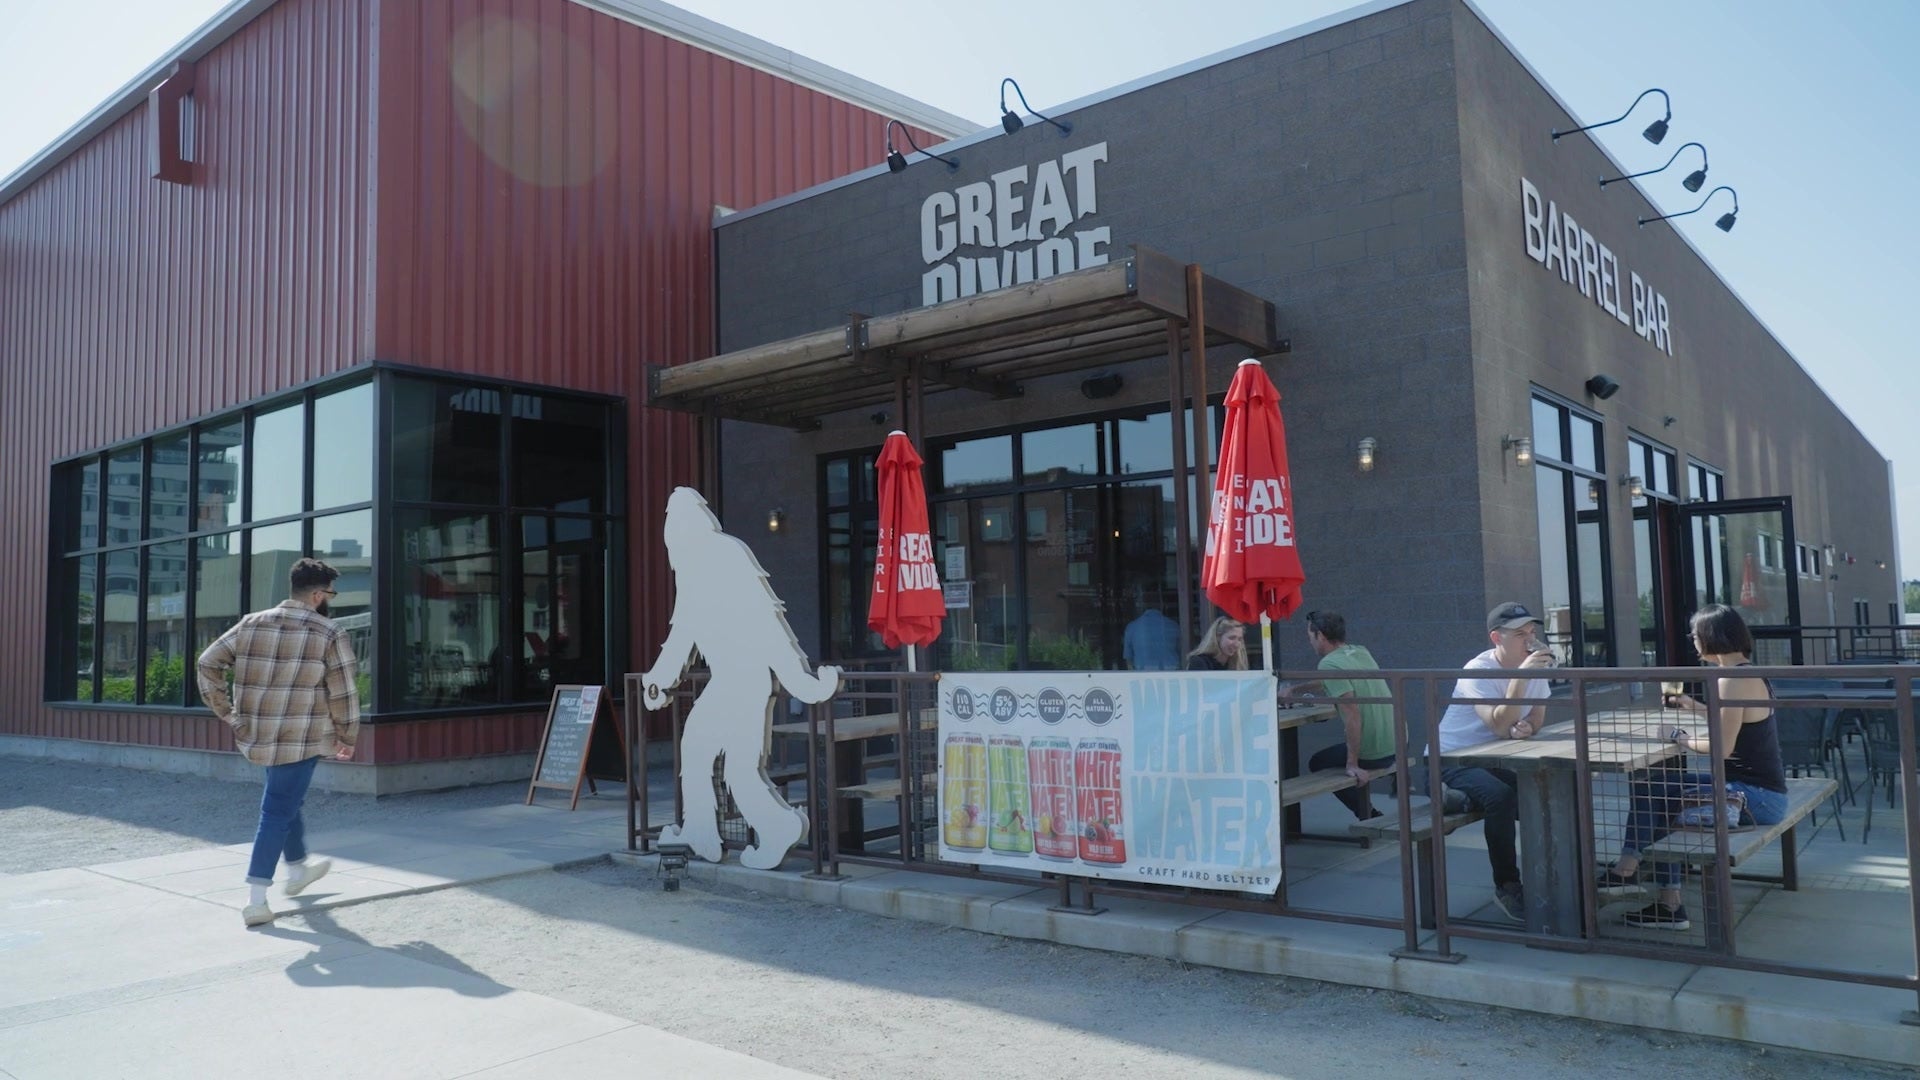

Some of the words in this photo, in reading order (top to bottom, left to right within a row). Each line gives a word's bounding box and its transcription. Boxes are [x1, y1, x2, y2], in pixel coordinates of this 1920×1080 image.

[921, 141, 1108, 265] GREAT
[1521, 176, 1631, 327] BARREL
[1630, 270, 1673, 357] BAR
[957, 704, 972, 715] CAL
[994, 706, 1013, 717] ABV
[995, 695, 1014, 707] 5%
[1085, 704, 1113, 713] NATURAL
[1130, 678, 1271, 774] WHITE
[1076, 751, 1122, 789] WHITE
[1130, 775, 1272, 868] WATER
[1138, 866, 1176, 877] CRAFT
[1181, 870, 1210, 881] HARD
[1215, 874, 1271, 886] SELTZER
